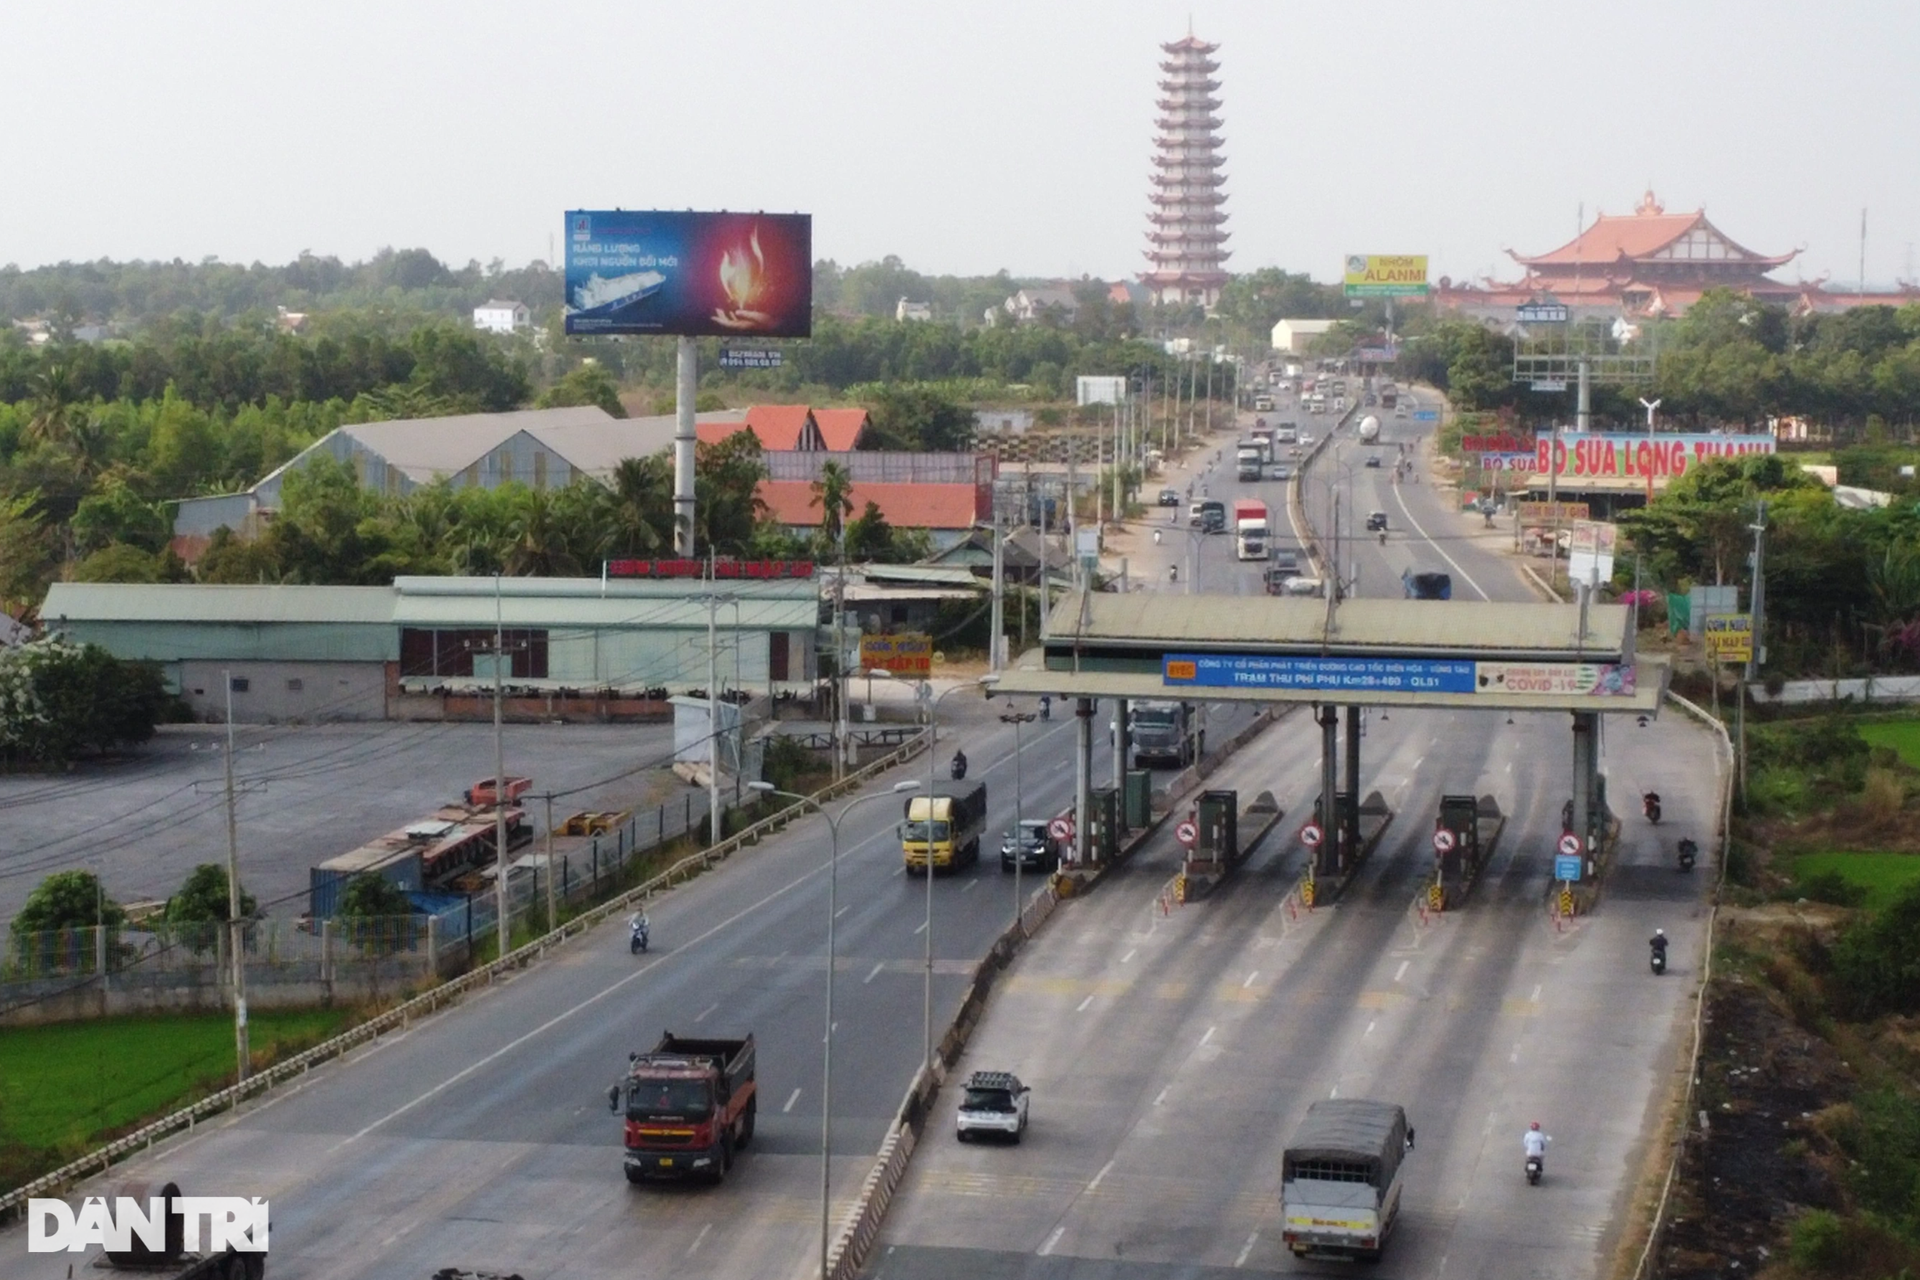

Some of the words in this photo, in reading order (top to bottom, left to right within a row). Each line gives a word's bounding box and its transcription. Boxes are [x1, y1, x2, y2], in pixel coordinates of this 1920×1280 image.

[1223, 660, 1233, 669] TY
[1234, 672, 1266, 684] TRẠM
[1269, 673, 1292, 684] THU
[1295, 673, 1314, 684] PHÍ
